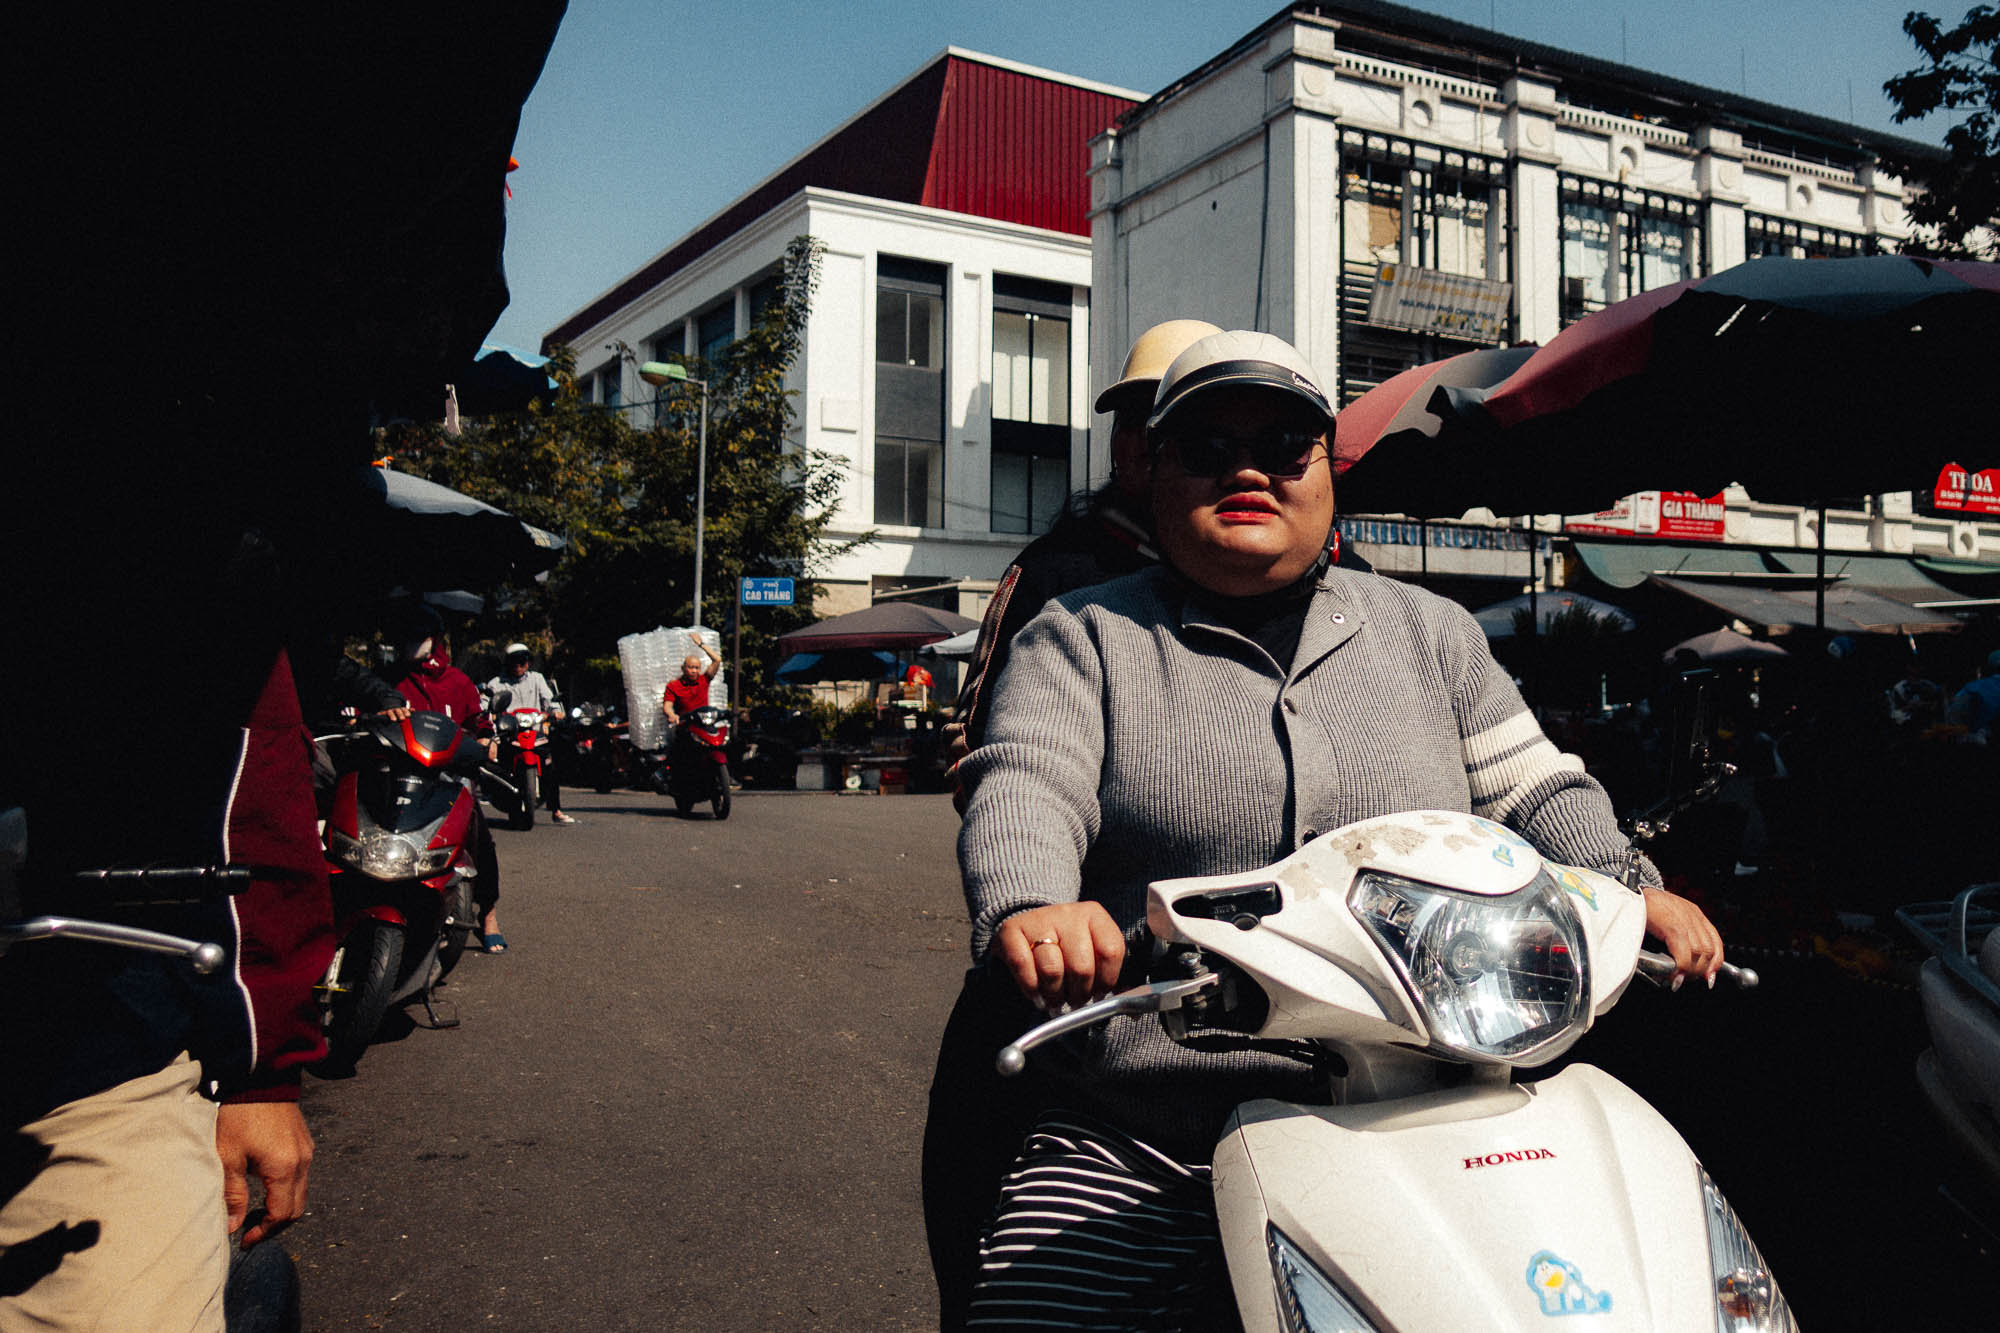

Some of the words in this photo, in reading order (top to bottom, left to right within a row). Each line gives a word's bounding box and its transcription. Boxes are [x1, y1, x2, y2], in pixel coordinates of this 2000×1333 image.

[1662, 500, 1683, 518] GIA
[745, 590, 762, 600] CAO
[1463, 1149, 1557, 1169] HONDA
